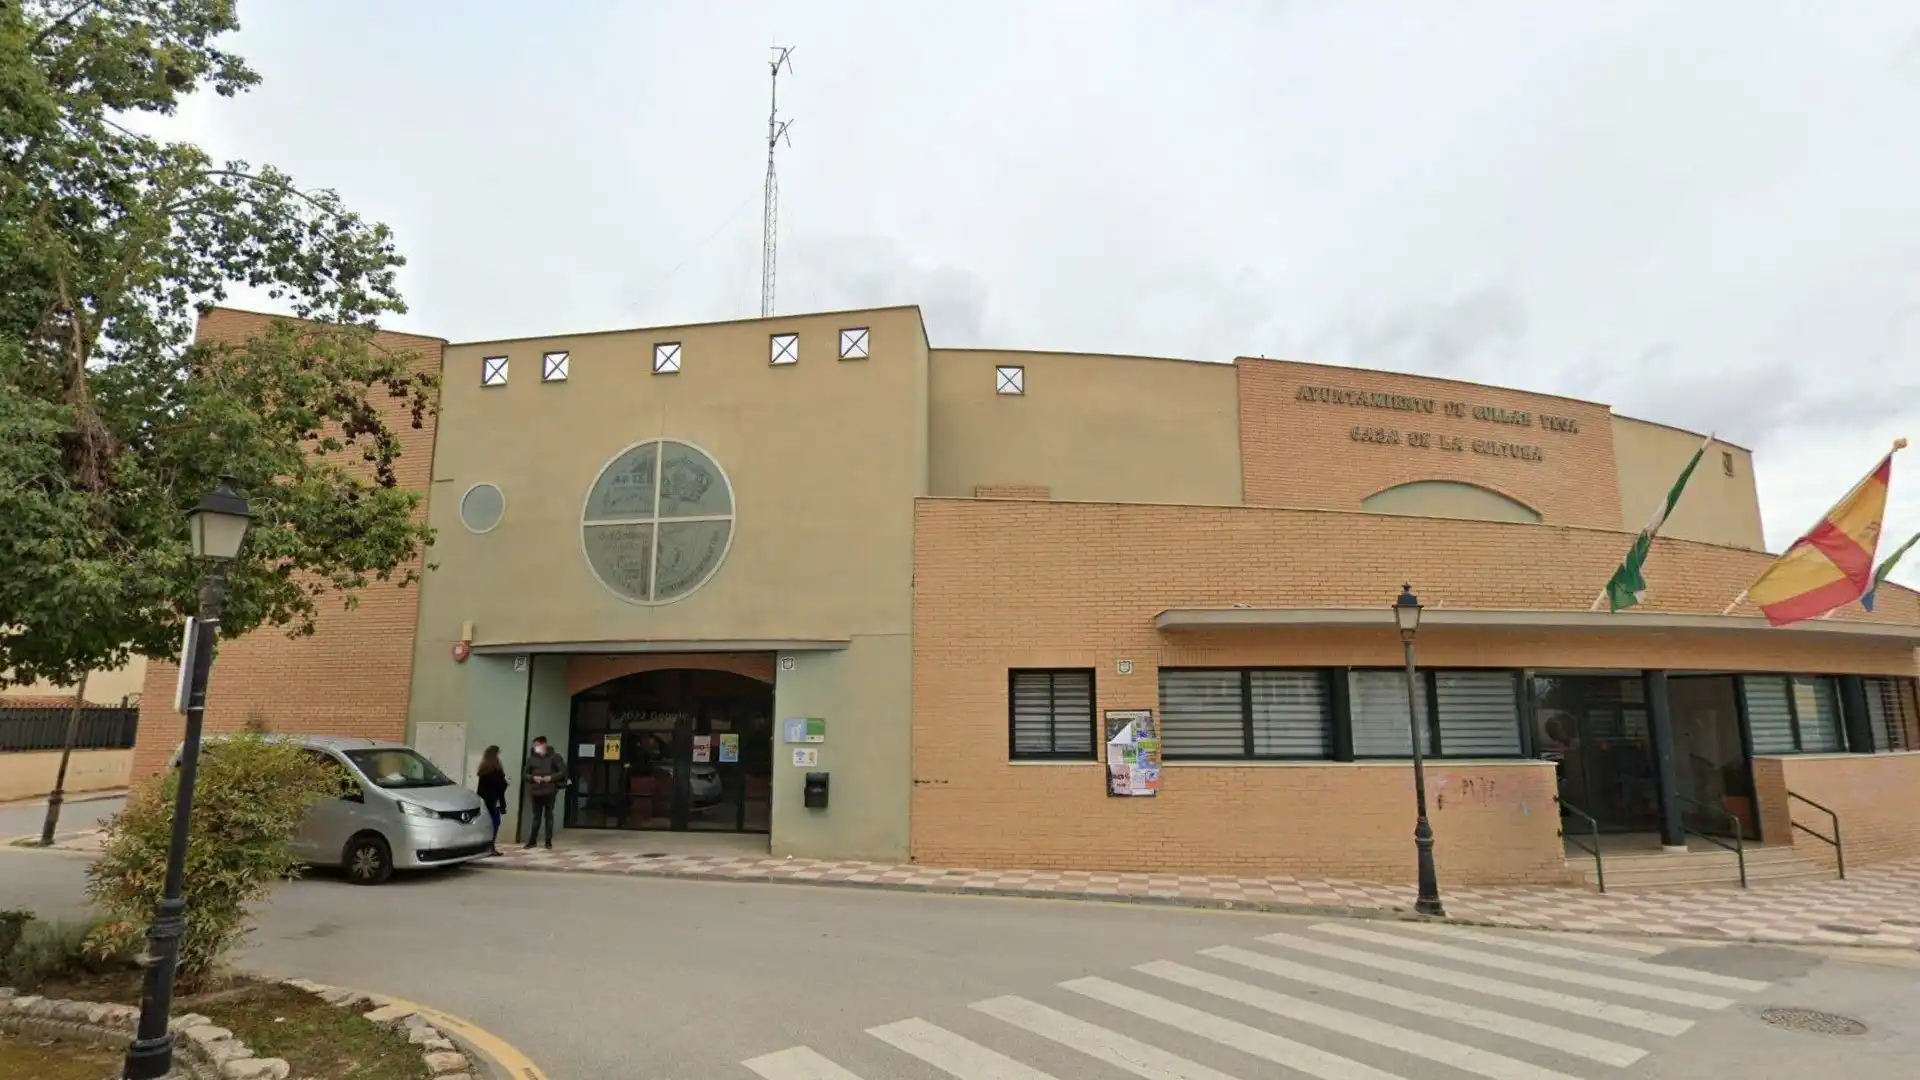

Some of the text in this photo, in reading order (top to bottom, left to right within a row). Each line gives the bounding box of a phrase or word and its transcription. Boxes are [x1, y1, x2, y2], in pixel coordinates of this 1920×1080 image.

[1296, 384, 1436, 413] AYUNTAMIENTO
[1444, 400, 1466, 418] DE
[1350, 425, 1543, 462] CASA DE LA CULTURA
